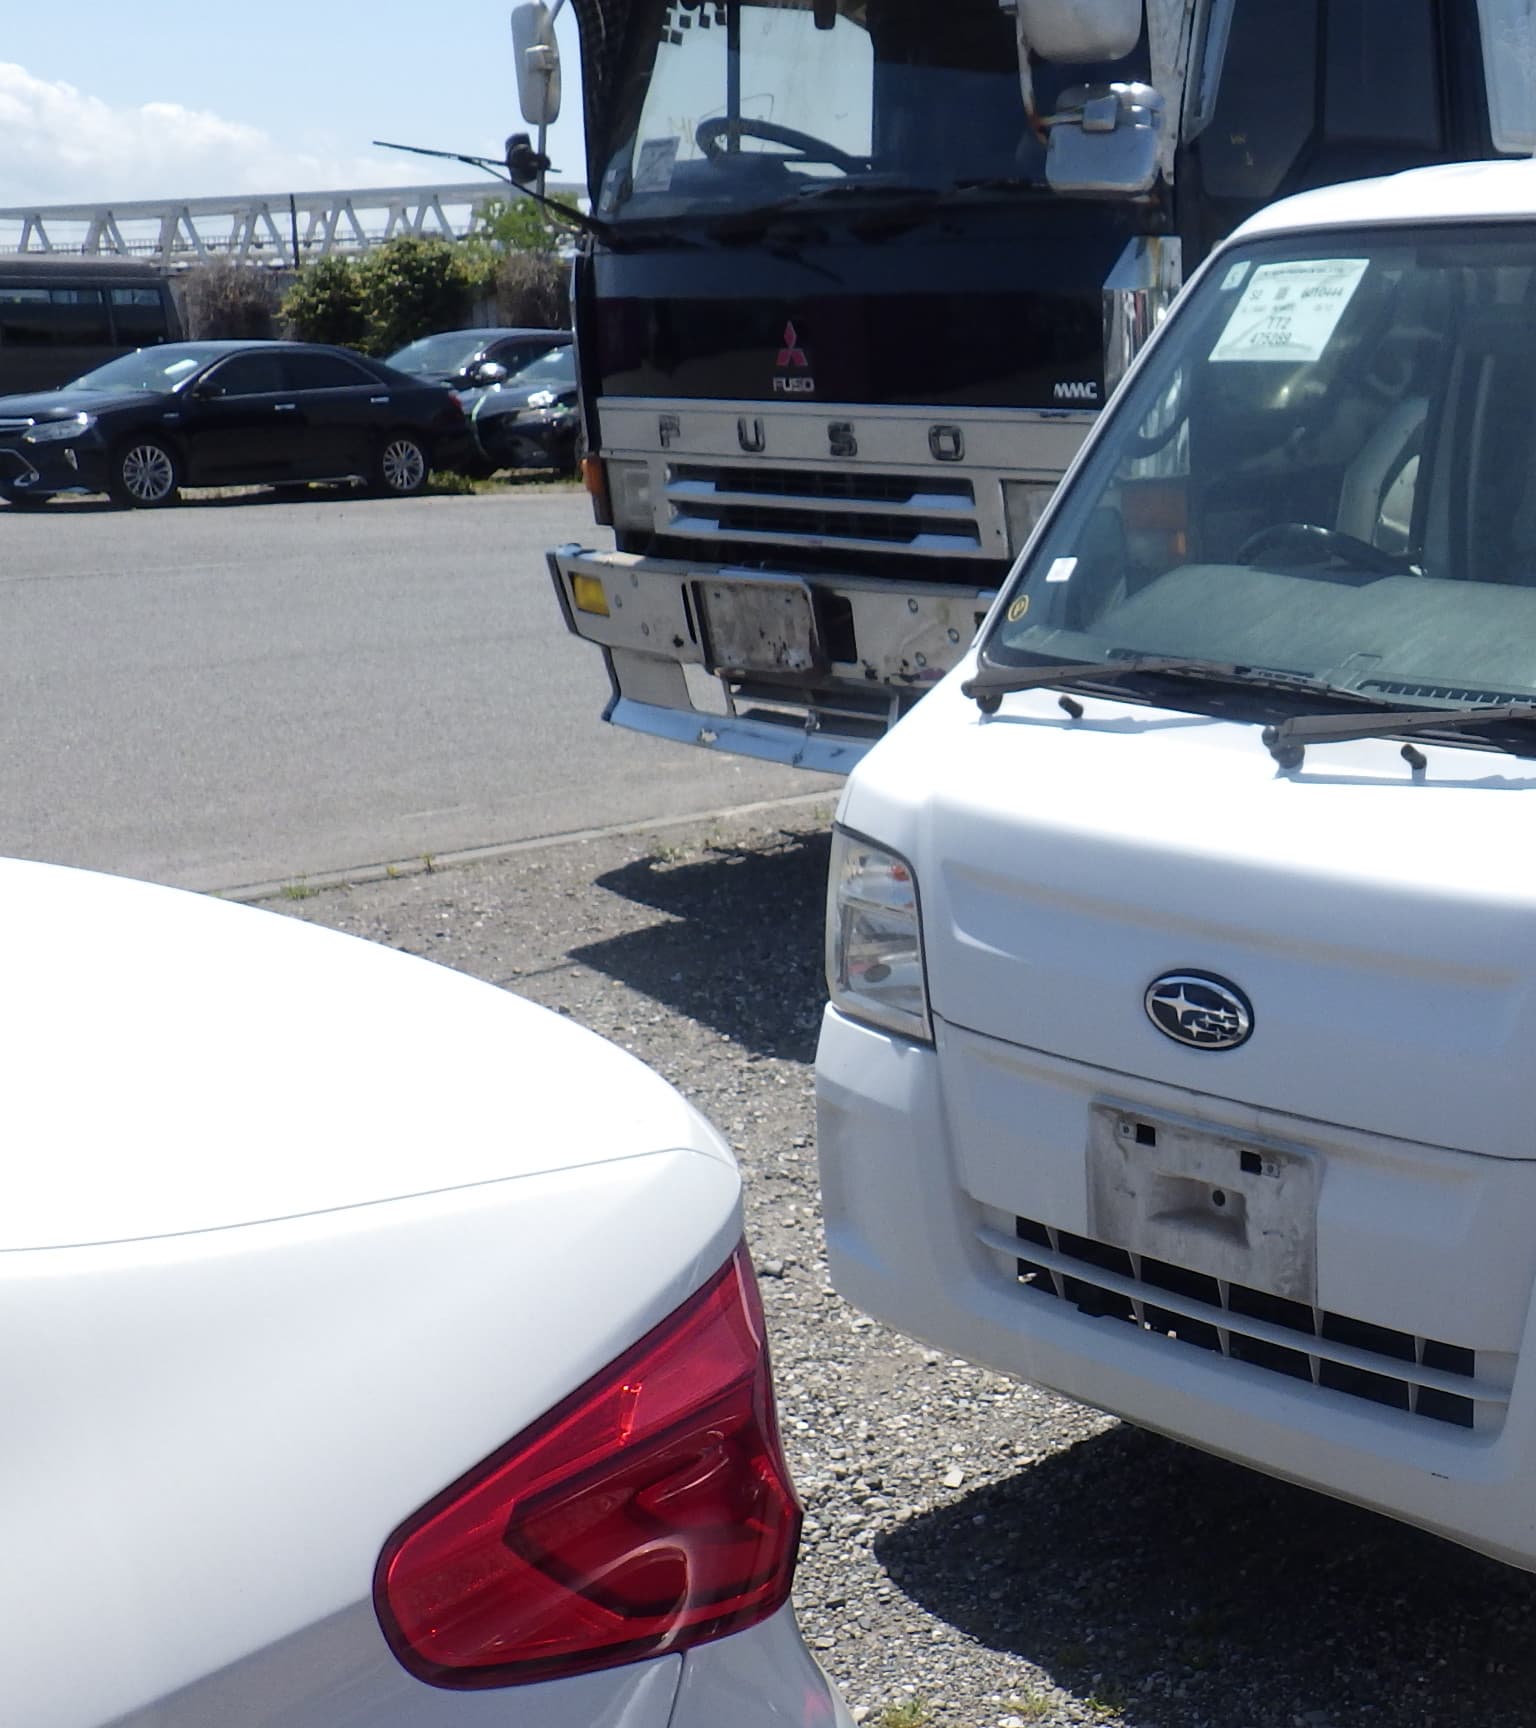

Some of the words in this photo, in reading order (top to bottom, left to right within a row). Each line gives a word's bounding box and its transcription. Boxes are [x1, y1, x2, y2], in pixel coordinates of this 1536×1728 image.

[772, 376, 815, 393] FUSO
[1052, 381, 1098, 399] MMC
[658, 414, 966, 462] FUSO
